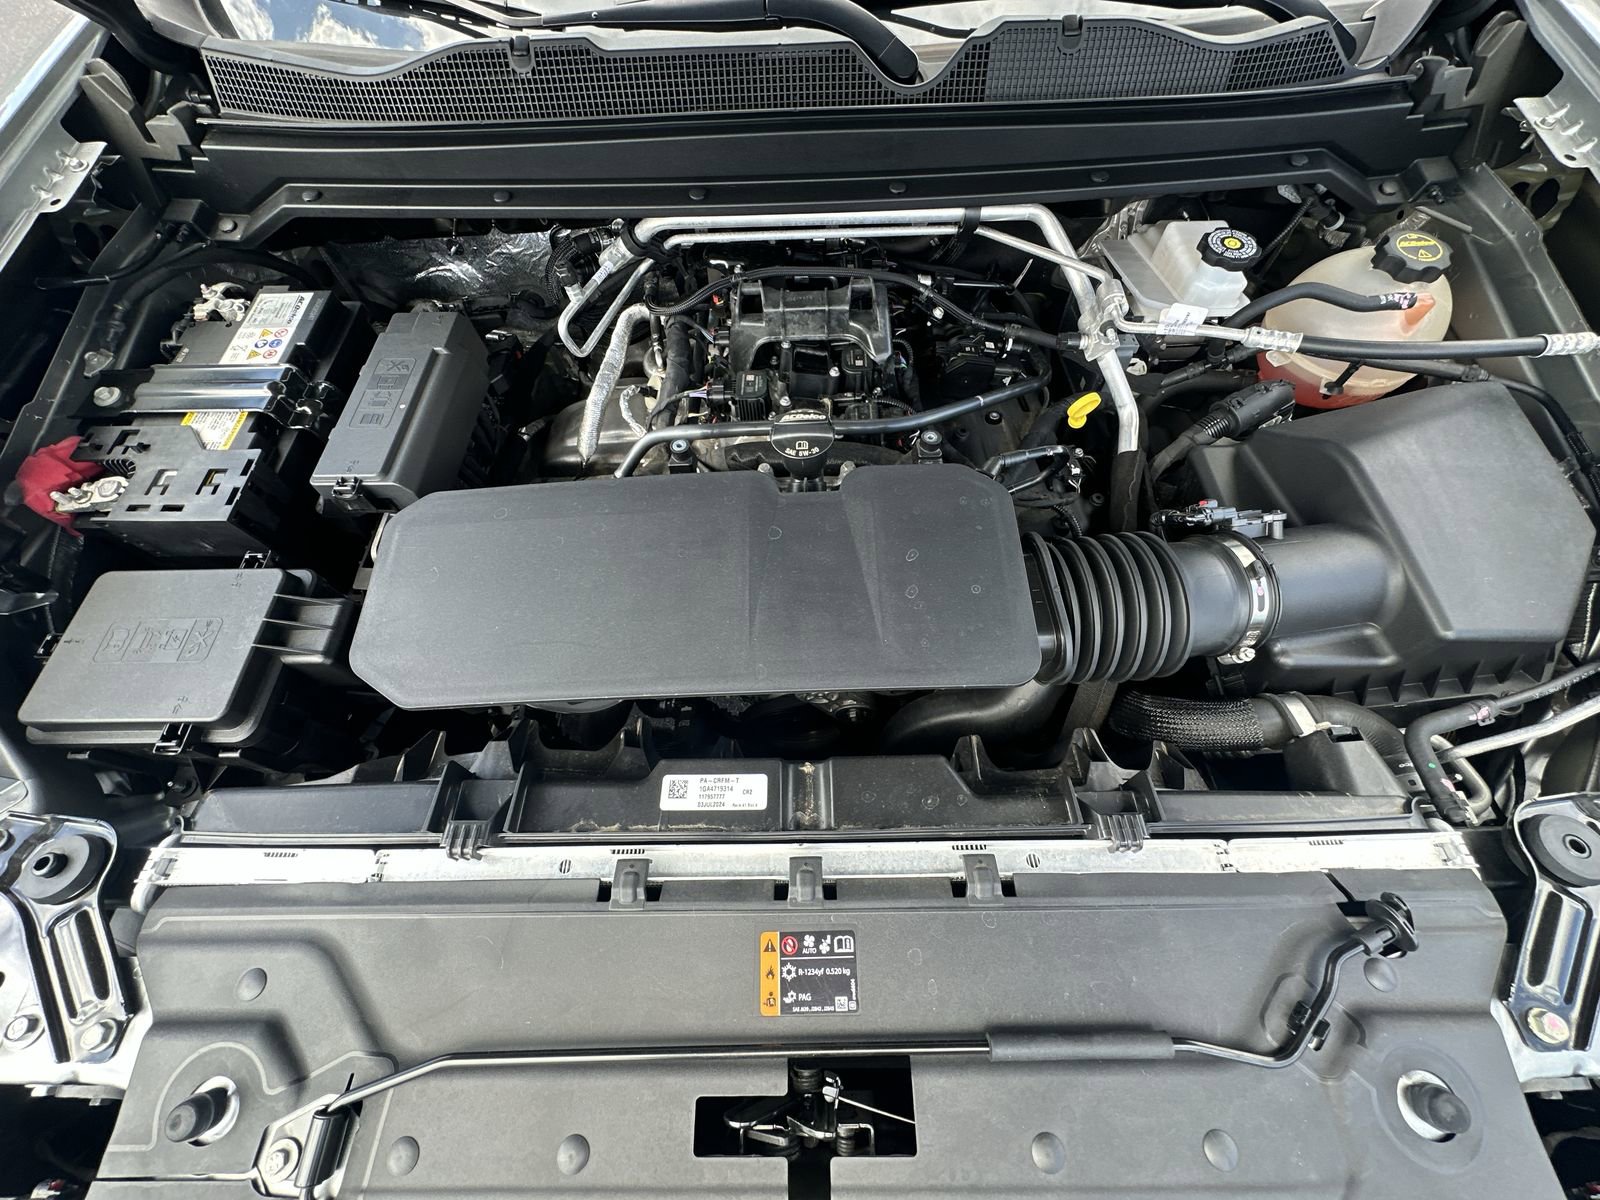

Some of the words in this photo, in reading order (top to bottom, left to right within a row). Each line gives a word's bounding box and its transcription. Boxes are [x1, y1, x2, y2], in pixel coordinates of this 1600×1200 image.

[779, 413, 827, 422] ACDelco
[785, 447, 797, 456] SAE
[798, 967, 824, 977] R-1234yf
[825, 967, 842, 975] 0.520
[842, 967, 851, 976] kg
[798, 993, 812, 1001] PAG
